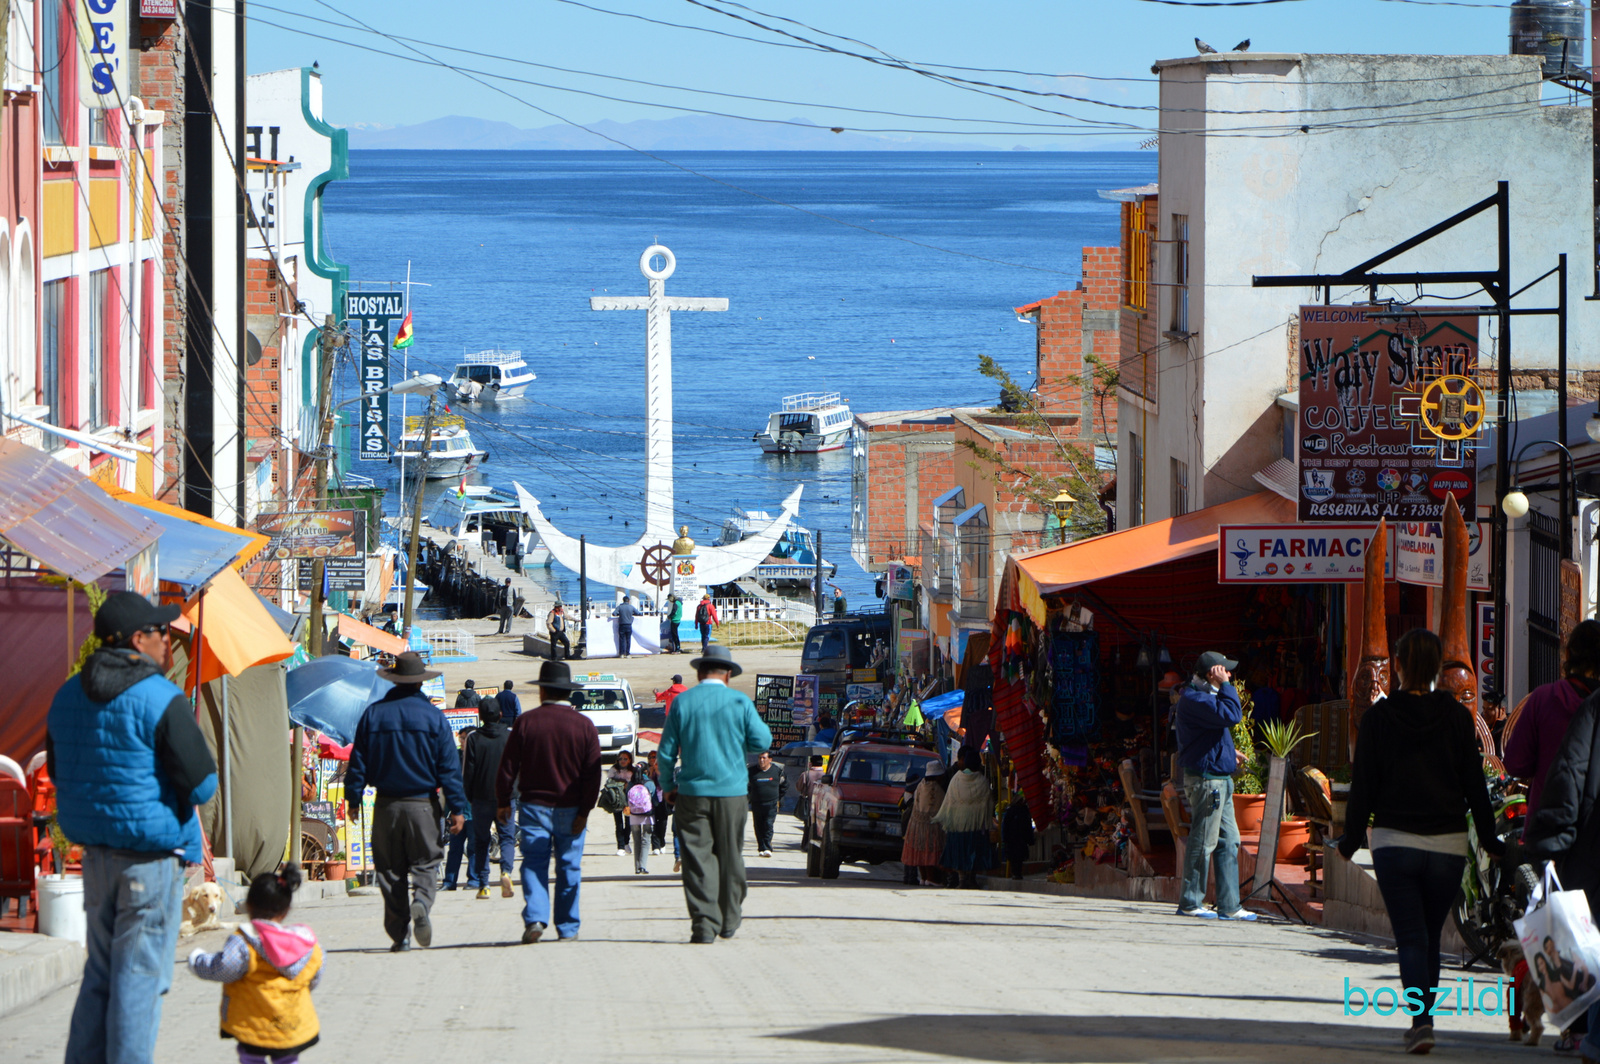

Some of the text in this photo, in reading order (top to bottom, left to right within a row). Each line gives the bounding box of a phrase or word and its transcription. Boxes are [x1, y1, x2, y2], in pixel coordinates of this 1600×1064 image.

[348, 297, 402, 315] HOSTAL
[1303, 311, 1369, 323] WELCOME
[364, 366, 385, 451] BRISAS
[1302, 459, 1322, 467] THE
[1324, 459, 1350, 467] BEST
[1353, 459, 1379, 467] FOOD
[1382, 459, 1409, 467] FROM
[1434, 481, 1468, 490] HAPPY HOUR
[1377, 491, 1400, 503] LFP
[1309, 503, 1379, 516] RESERVAS
[1383, 503, 1399, 516] AL
[337, 517, 352, 527] BAR
[1259, 538, 1388, 558] FARMACI
[758, 567, 813, 576] CAPRICHO
